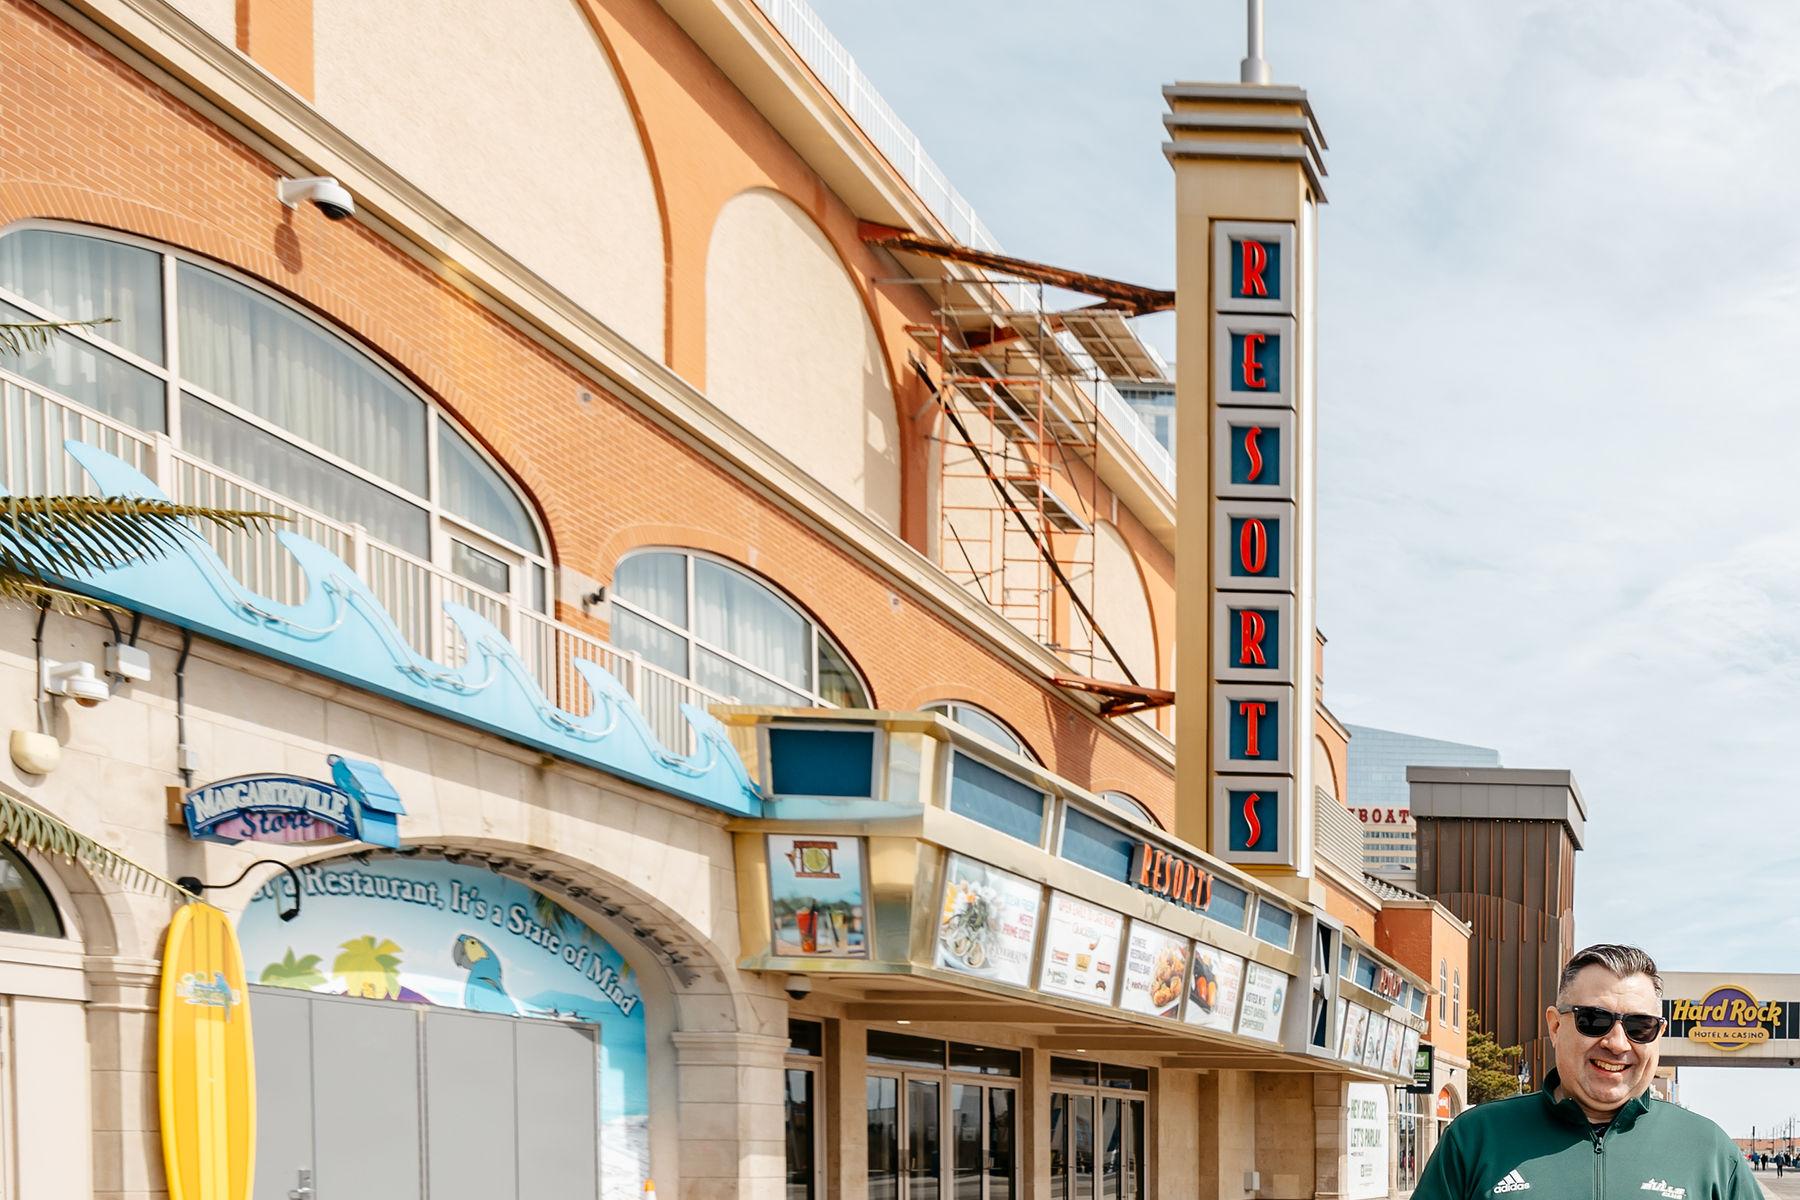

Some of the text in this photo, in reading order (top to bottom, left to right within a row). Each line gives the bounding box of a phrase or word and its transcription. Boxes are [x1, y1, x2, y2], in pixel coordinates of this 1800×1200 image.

[1240, 239, 1268, 849] RESORTS
[190, 781, 349, 824] MARGARITAVILLE
[1347, 808, 1410, 824] BOAT
[240, 808, 314, 837] Store
[1140, 843, 1213, 912] RESORTS
[302, 866, 444, 911] Restaurant,
[449, 880, 487, 919] It's
[491, 908, 503, 926] a
[504, 904, 560, 956] State
[563, 945, 591, 973] of
[586, 955, 640, 1017] Mind
[1673, 999, 1782, 1026] Hard Rock
[1694, 1031, 1764, 1039] HOTEL & CASINO
[1494, 1182, 1530, 1194] adidas
